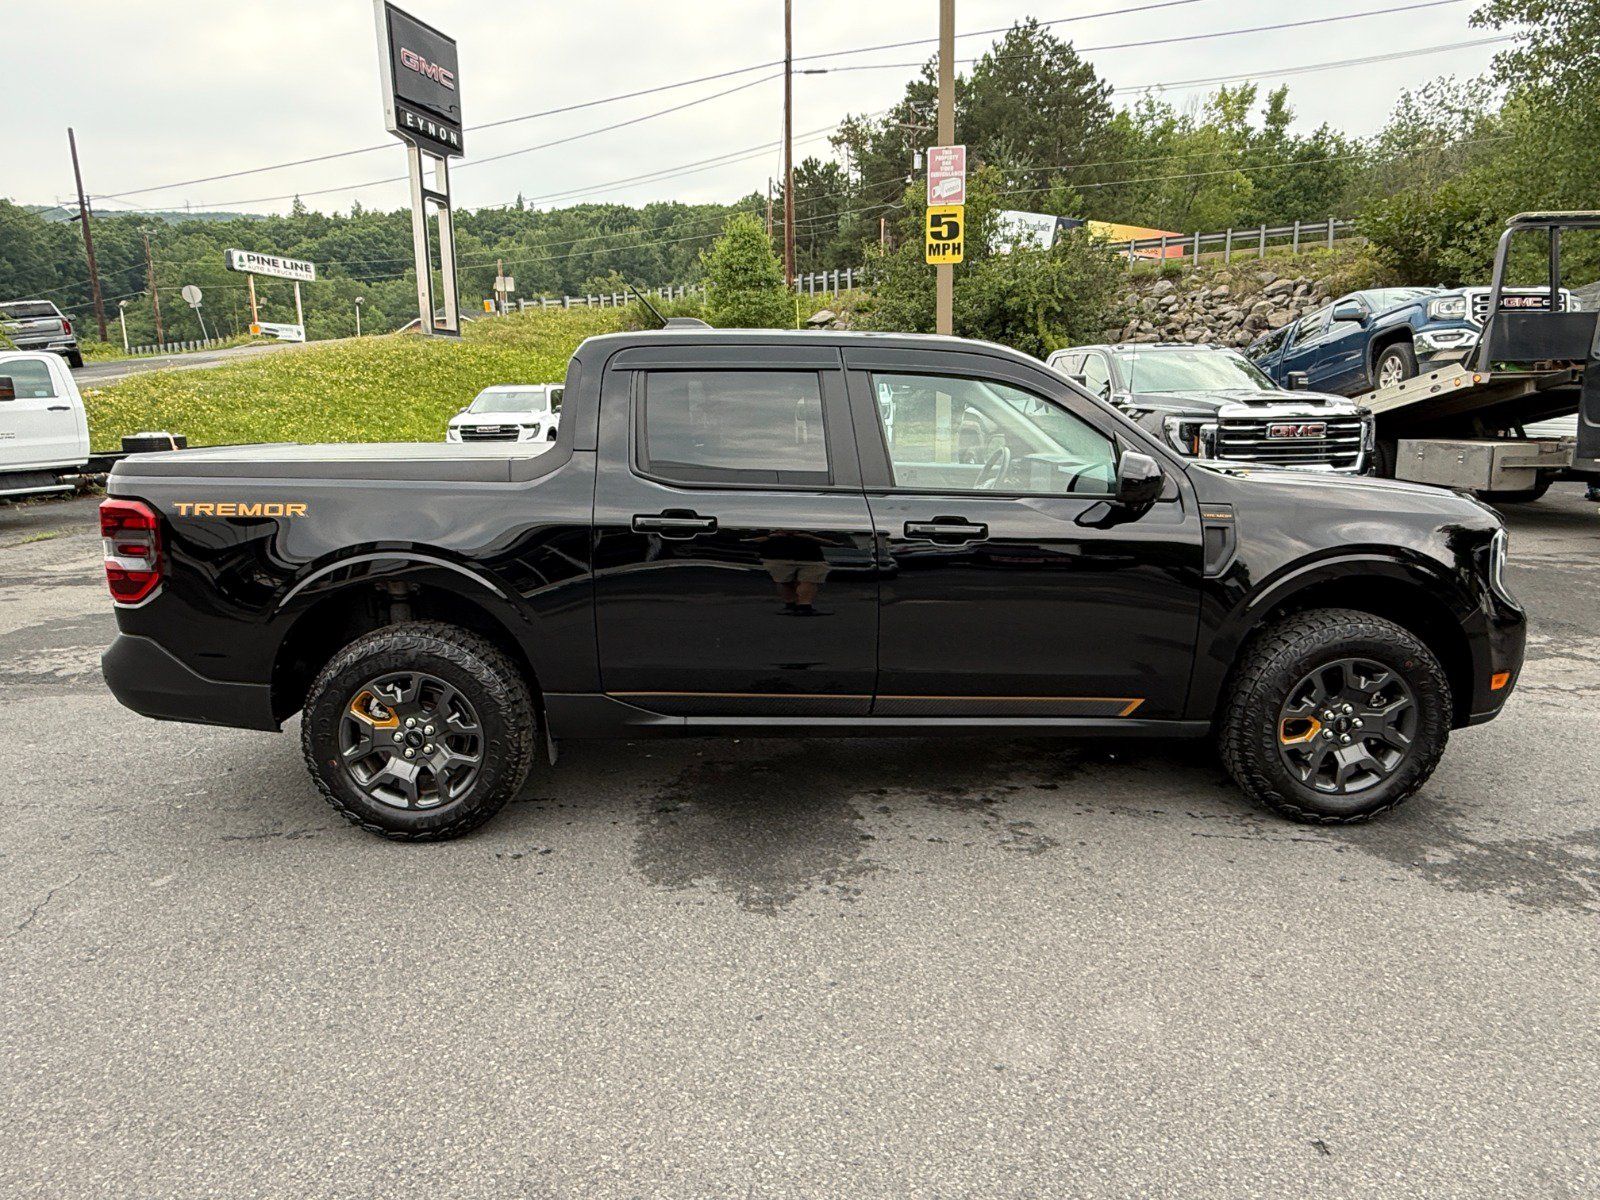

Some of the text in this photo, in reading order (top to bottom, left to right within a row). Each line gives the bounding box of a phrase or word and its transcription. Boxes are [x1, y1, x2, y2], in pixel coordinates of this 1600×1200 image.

[400, 47, 455, 91] GMC
[406, 112, 458, 146] EYNON
[930, 213, 960, 240] 5
[928, 242, 961, 257] MPH
[247, 254, 312, 273] PINE LINE
[273, 268, 292, 276] TRUCK
[1503, 297, 1542, 307] GMC
[1271, 425, 1324, 437] GMC
[174, 502, 308, 516] TREMOR
